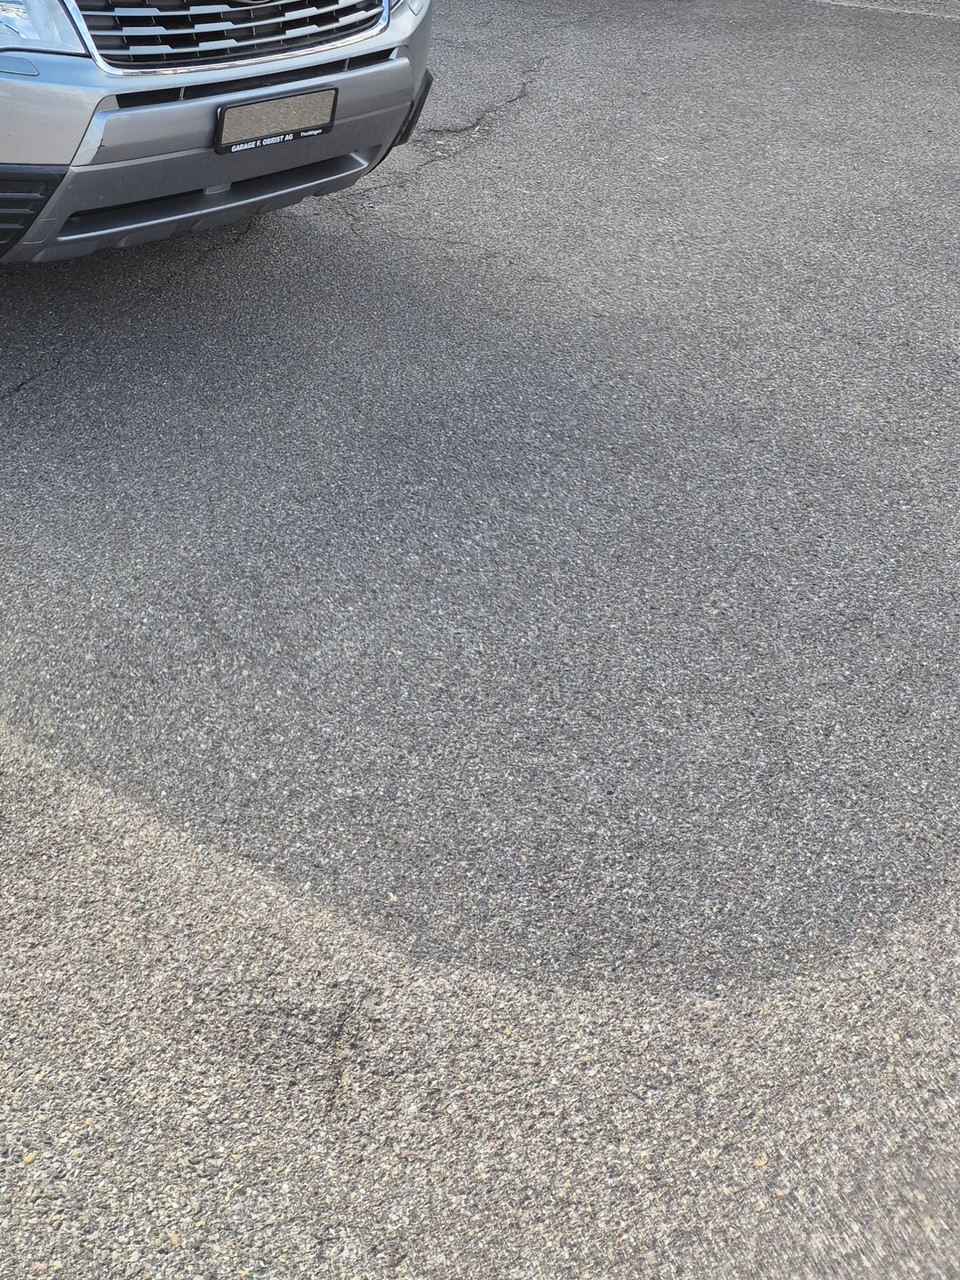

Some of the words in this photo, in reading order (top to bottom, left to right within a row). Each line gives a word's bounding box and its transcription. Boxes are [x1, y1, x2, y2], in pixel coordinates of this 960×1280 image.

[231, 141, 256, 153] GARAGE
[262, 135, 284, 145] OBRIST
[285, 133, 294, 141] AG
